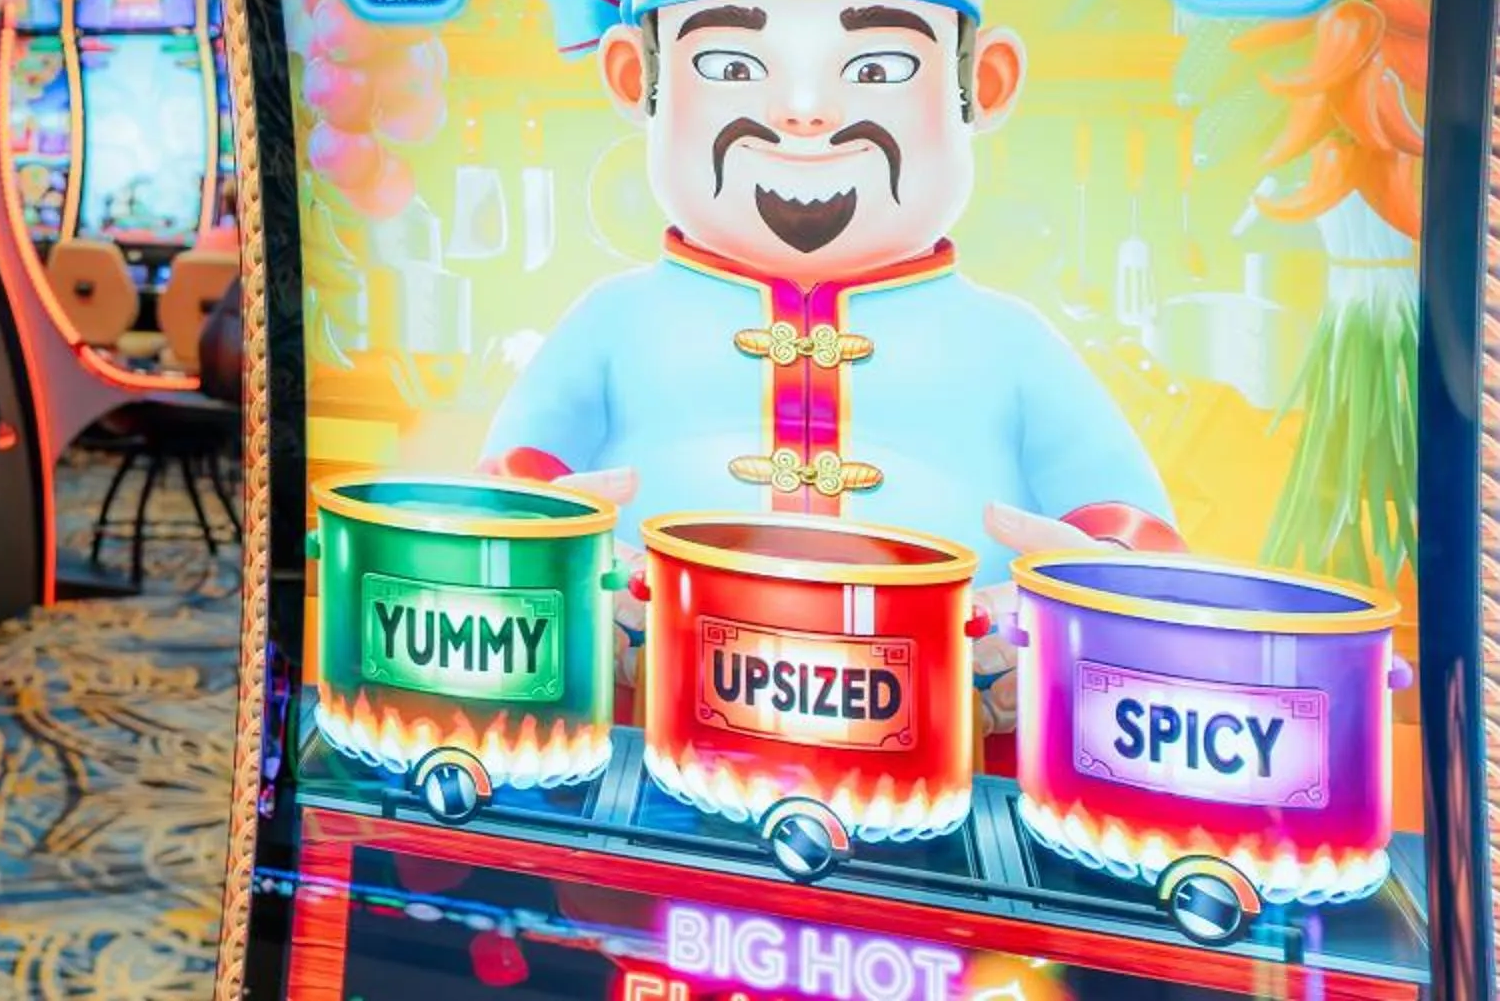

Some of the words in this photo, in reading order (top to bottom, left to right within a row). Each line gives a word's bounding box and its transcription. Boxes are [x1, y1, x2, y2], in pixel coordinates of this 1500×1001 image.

[374, 601, 549, 675] YUMMY
[712, 649, 903, 721] UPSIZED
[1113, 698, 1285, 779] SPICY
[665, 908, 787, 988] BIG
[799, 928, 964, 1001] HOT
